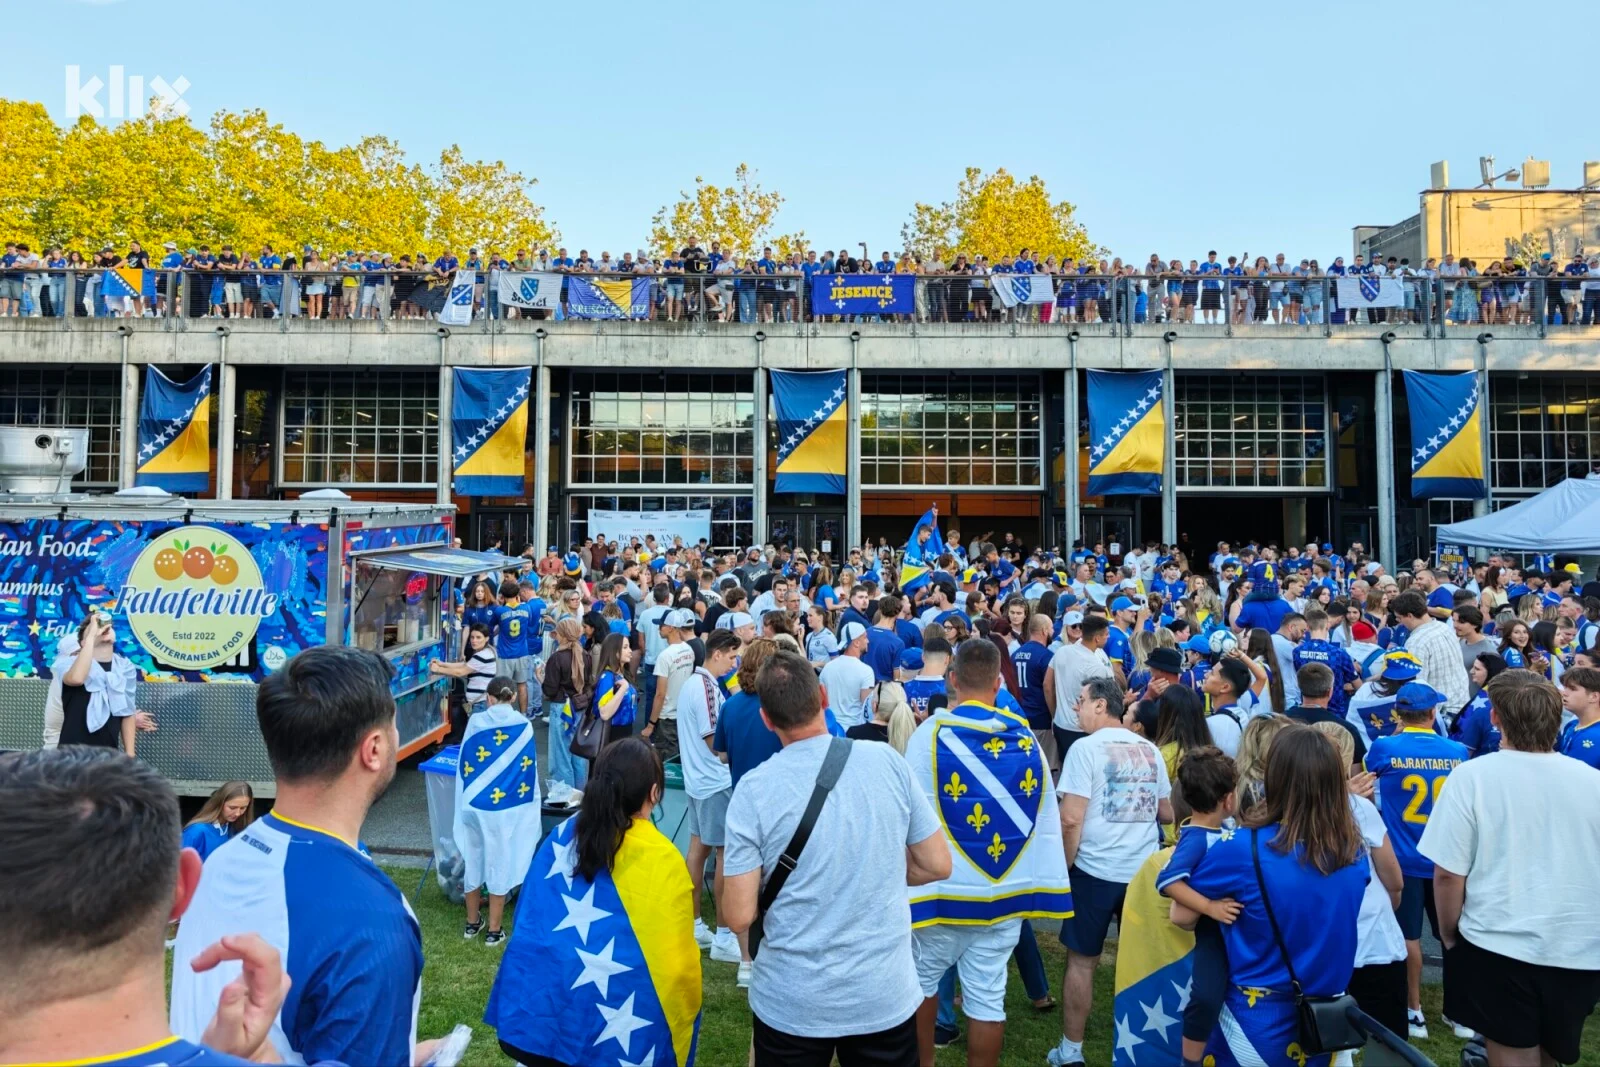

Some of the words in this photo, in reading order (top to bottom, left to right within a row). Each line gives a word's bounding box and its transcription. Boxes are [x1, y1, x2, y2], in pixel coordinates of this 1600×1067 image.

[830, 286, 893, 300] JESENICE
[38, 534, 97, 557] Food
[1264, 564, 1275, 582] 4
[0, 582, 65, 596] ummus
[407, 577, 428, 597] OPEN
[112, 585, 279, 620] Falafelville
[172, 631, 192, 640] Estd
[194, 632, 216, 640] 2022
[509, 619, 521, 637] 9
[145, 630, 221, 662] MEDITERRANEAN
[222, 630, 244, 653] FOOD
[1015, 661, 1029, 689] 11
